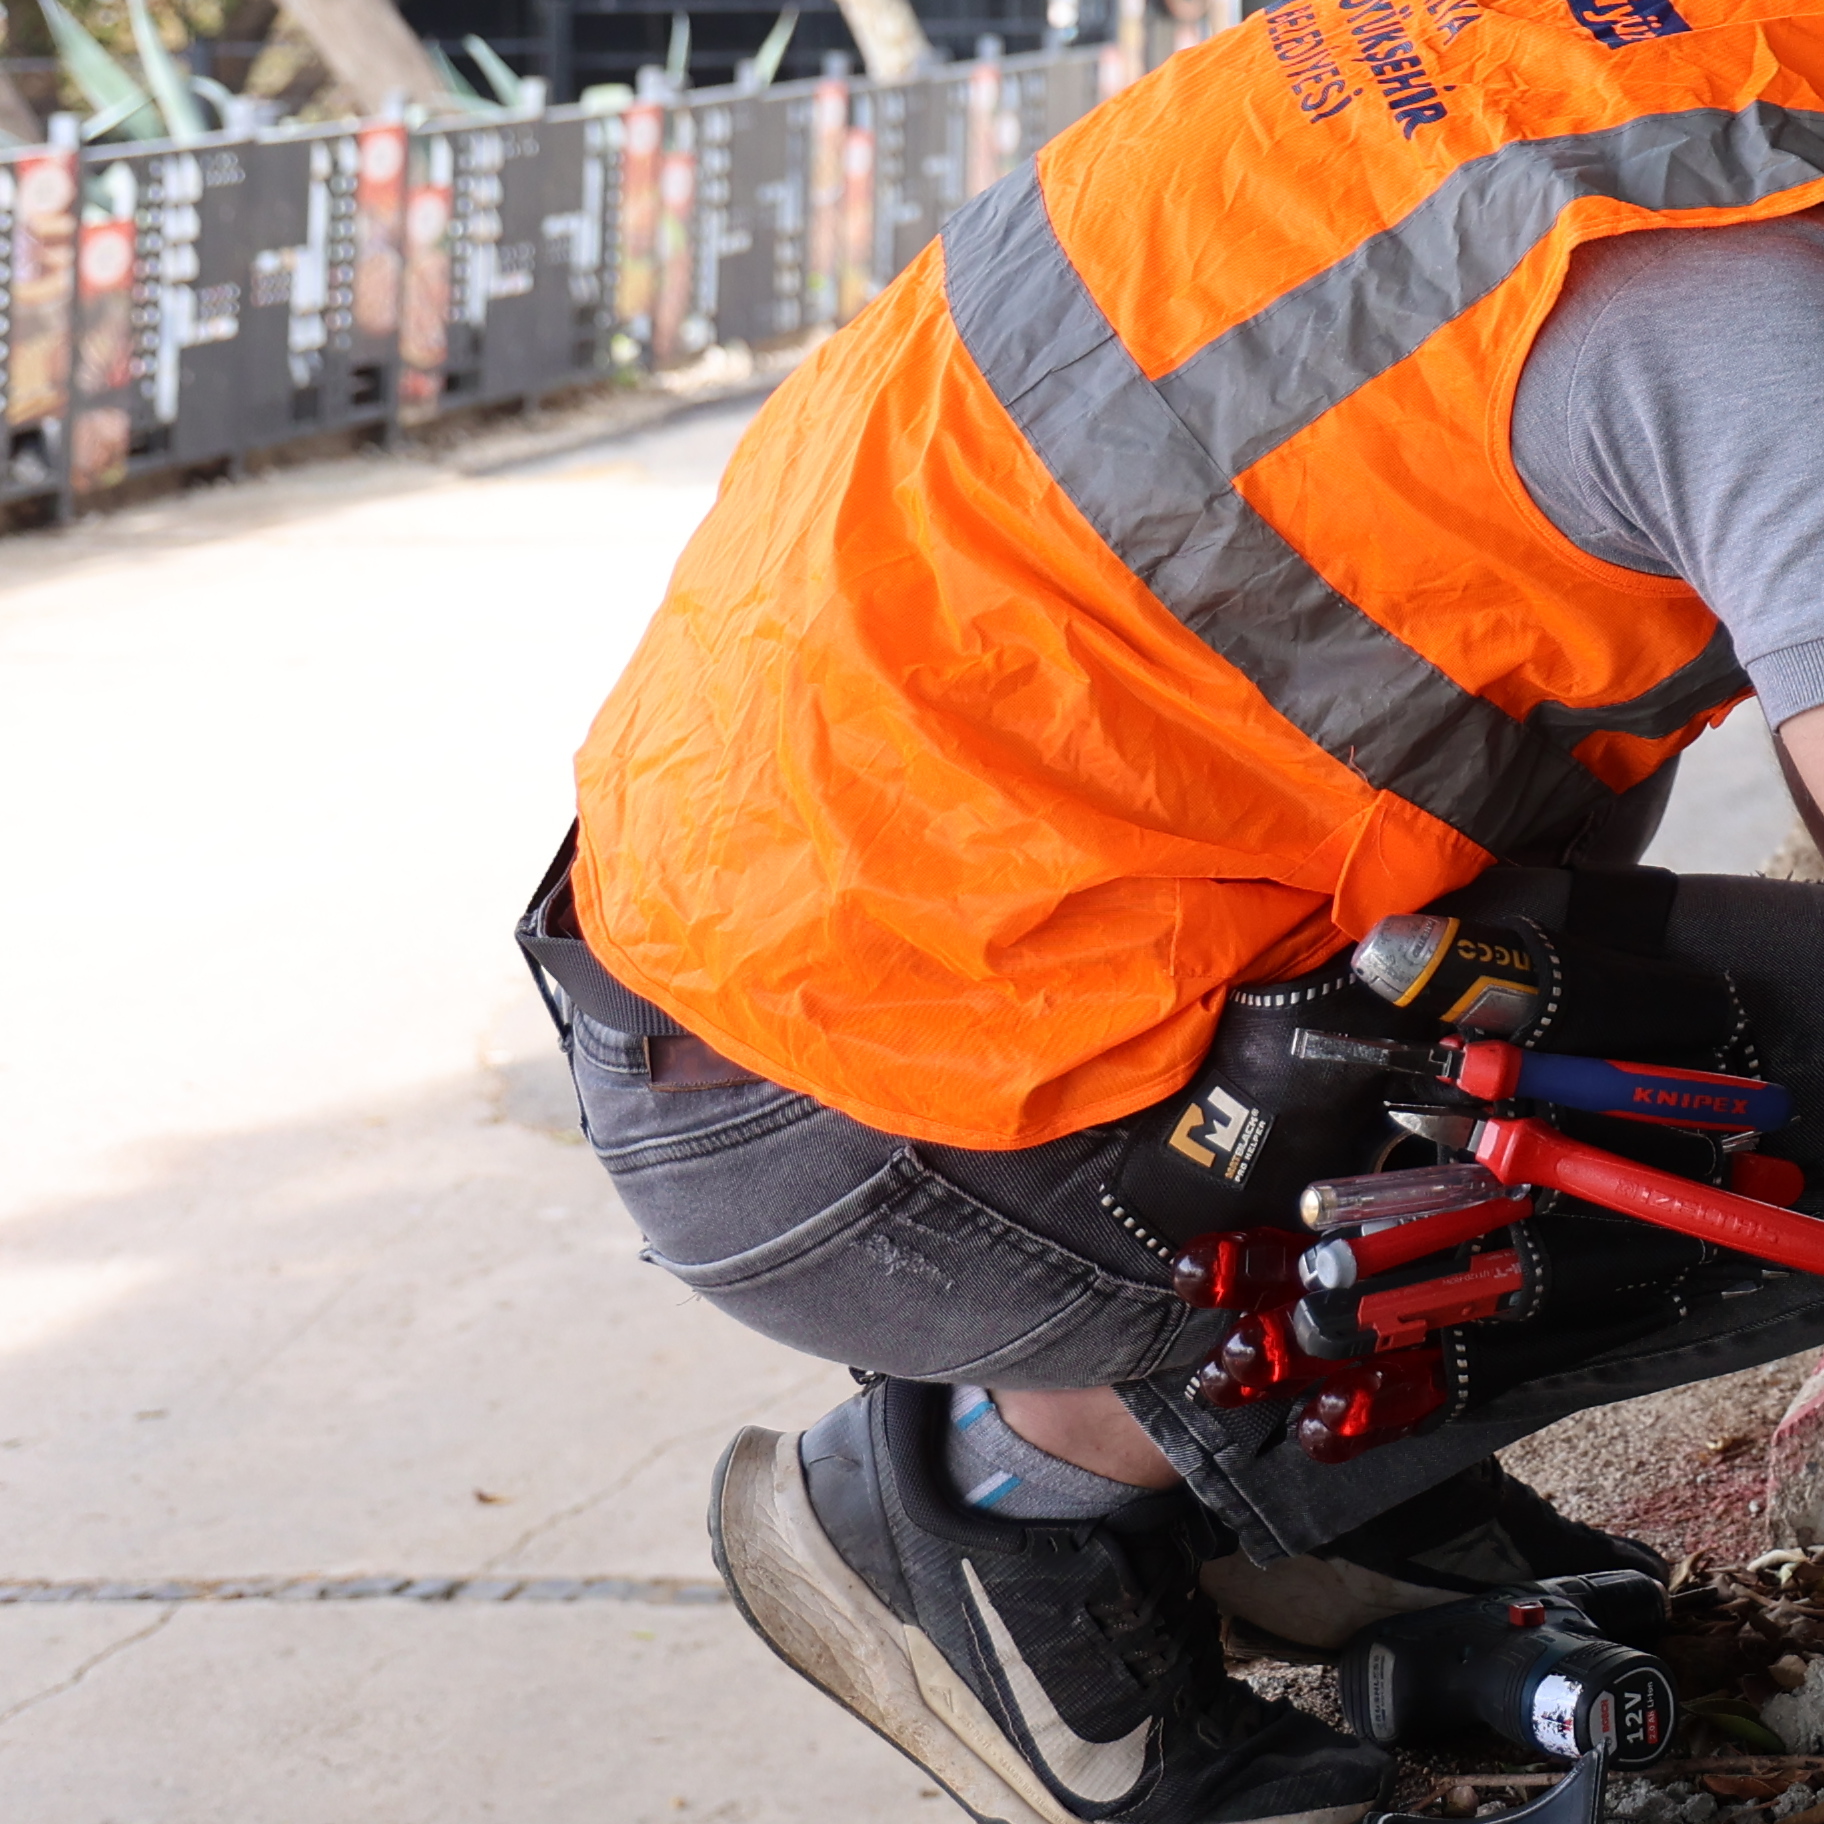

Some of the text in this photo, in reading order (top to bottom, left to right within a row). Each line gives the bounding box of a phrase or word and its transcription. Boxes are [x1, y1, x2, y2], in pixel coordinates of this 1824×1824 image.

[1632, 1087, 1749, 1115] KNIPEX
[1234, 1120, 1266, 1183] PRO HELPER
[1624, 1692, 1645, 1744] 12V
